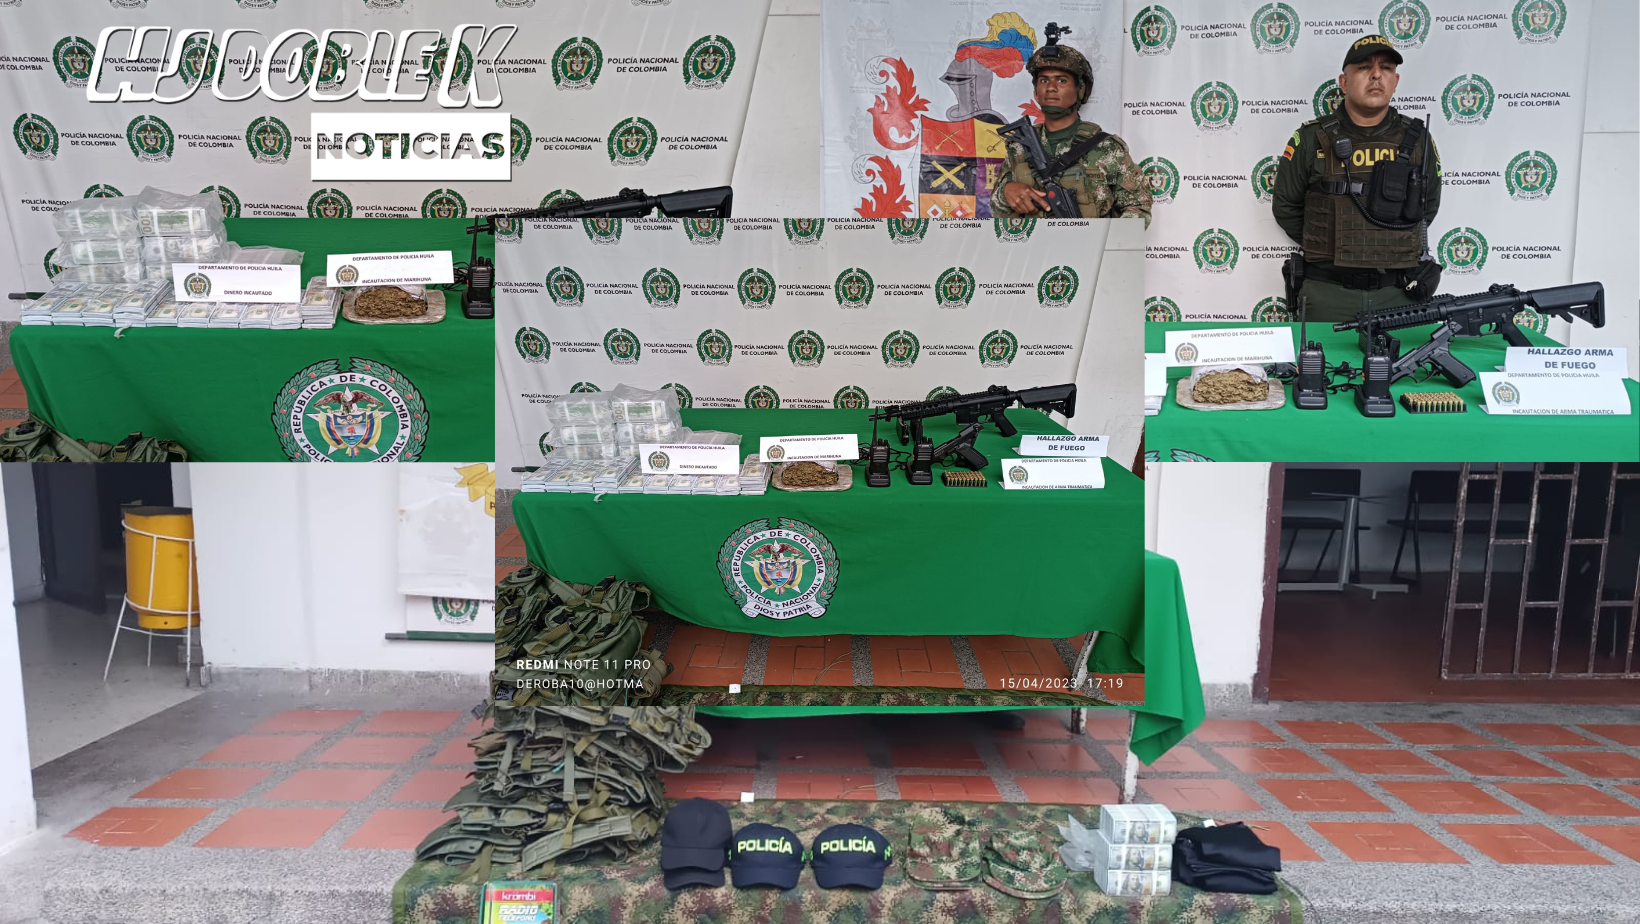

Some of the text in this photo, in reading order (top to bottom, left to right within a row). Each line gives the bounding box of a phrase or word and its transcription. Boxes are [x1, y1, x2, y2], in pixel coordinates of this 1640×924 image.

[1456, 22, 1497, 30] COLOMBIA
[1201, 31, 1237, 39] COLOMBIA
[1498, 91, 1529, 99] POLICÍA
[1341, 148, 1400, 167] OLICI
[1528, 348, 1581, 356] HALLAZGO
[339, 375, 356, 383] DE
[369, 379, 409, 430] COLOMBIA
[793, 534, 824, 574] COLOMBIA
[782, 582, 821, 608] NACIONAL
[783, 604, 813, 617] PATRIA
[737, 836, 793, 854] POLICÍA
[820, 835, 876, 854] POLICÍA
[499, 905, 539, 915] RADIO
